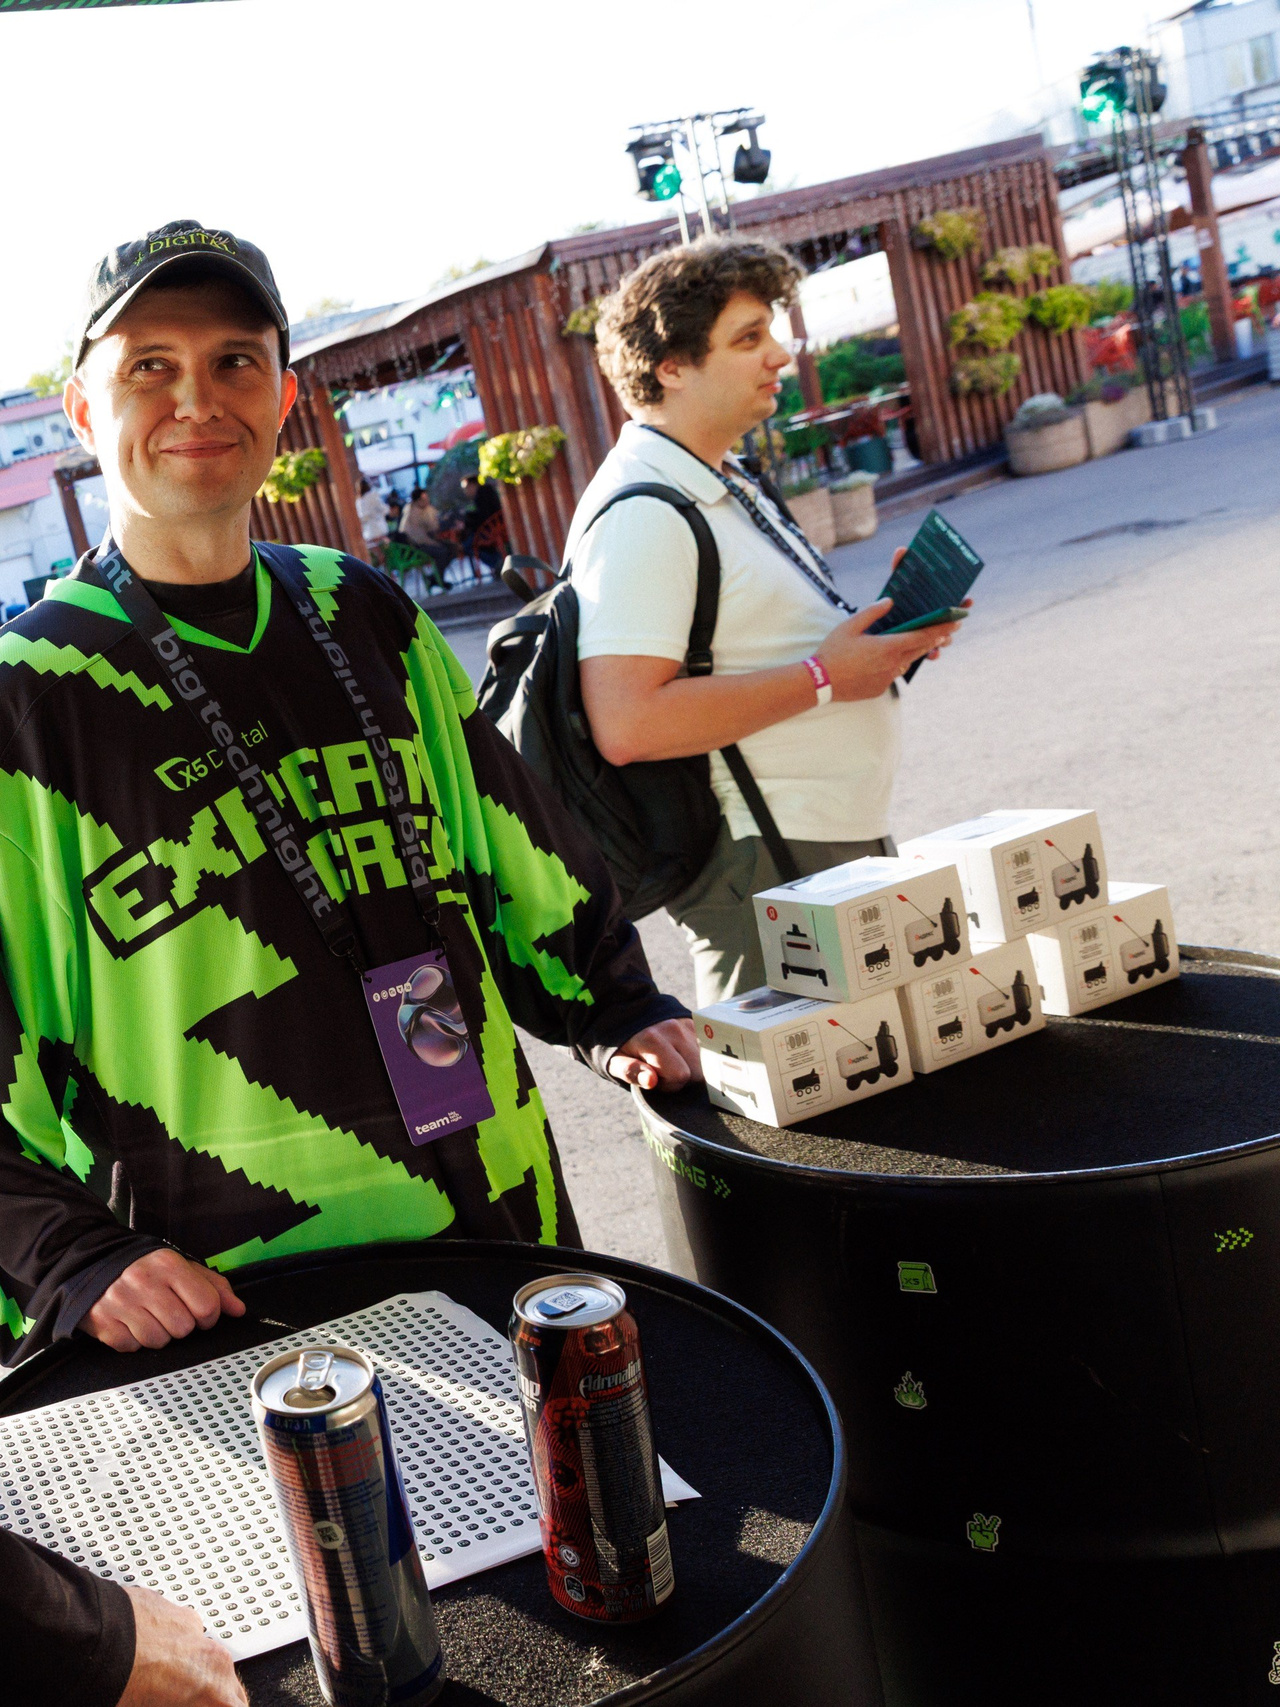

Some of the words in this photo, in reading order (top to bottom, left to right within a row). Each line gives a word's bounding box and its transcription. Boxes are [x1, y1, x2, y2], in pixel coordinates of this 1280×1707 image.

[151, 626, 207, 701] big
[199, 700, 264, 800] tech
[256, 797, 333, 919] night
[177, 757, 209, 789] X5
[210, 720, 270, 770] Dtal
[397, 810, 430, 889] big
[415, 1116, 450, 1135] team
